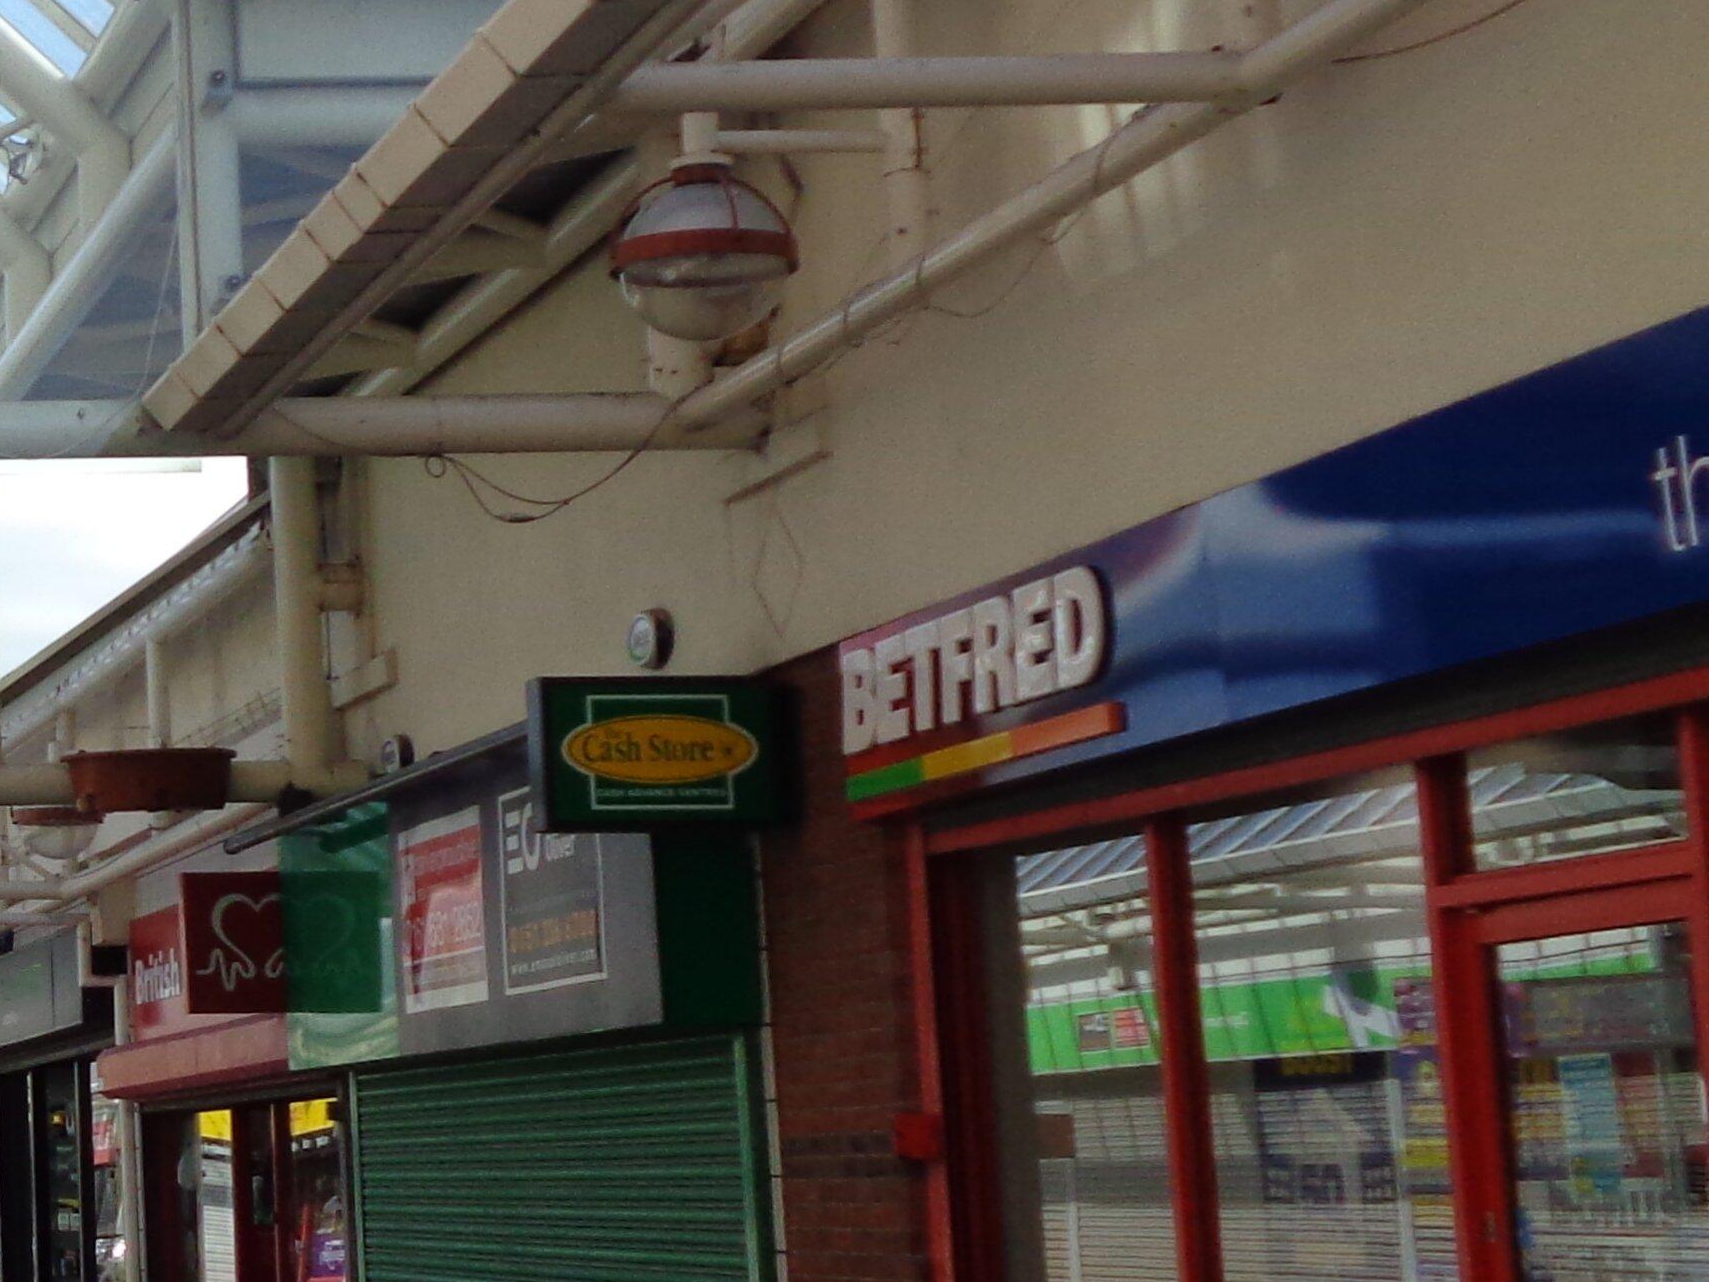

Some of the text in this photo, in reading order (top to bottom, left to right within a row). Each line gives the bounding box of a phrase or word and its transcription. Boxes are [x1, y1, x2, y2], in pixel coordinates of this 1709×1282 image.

[839, 564, 1107, 757] BETFRED
[582, 730, 715, 763] Cash Store
[134, 947, 181, 1005] British
